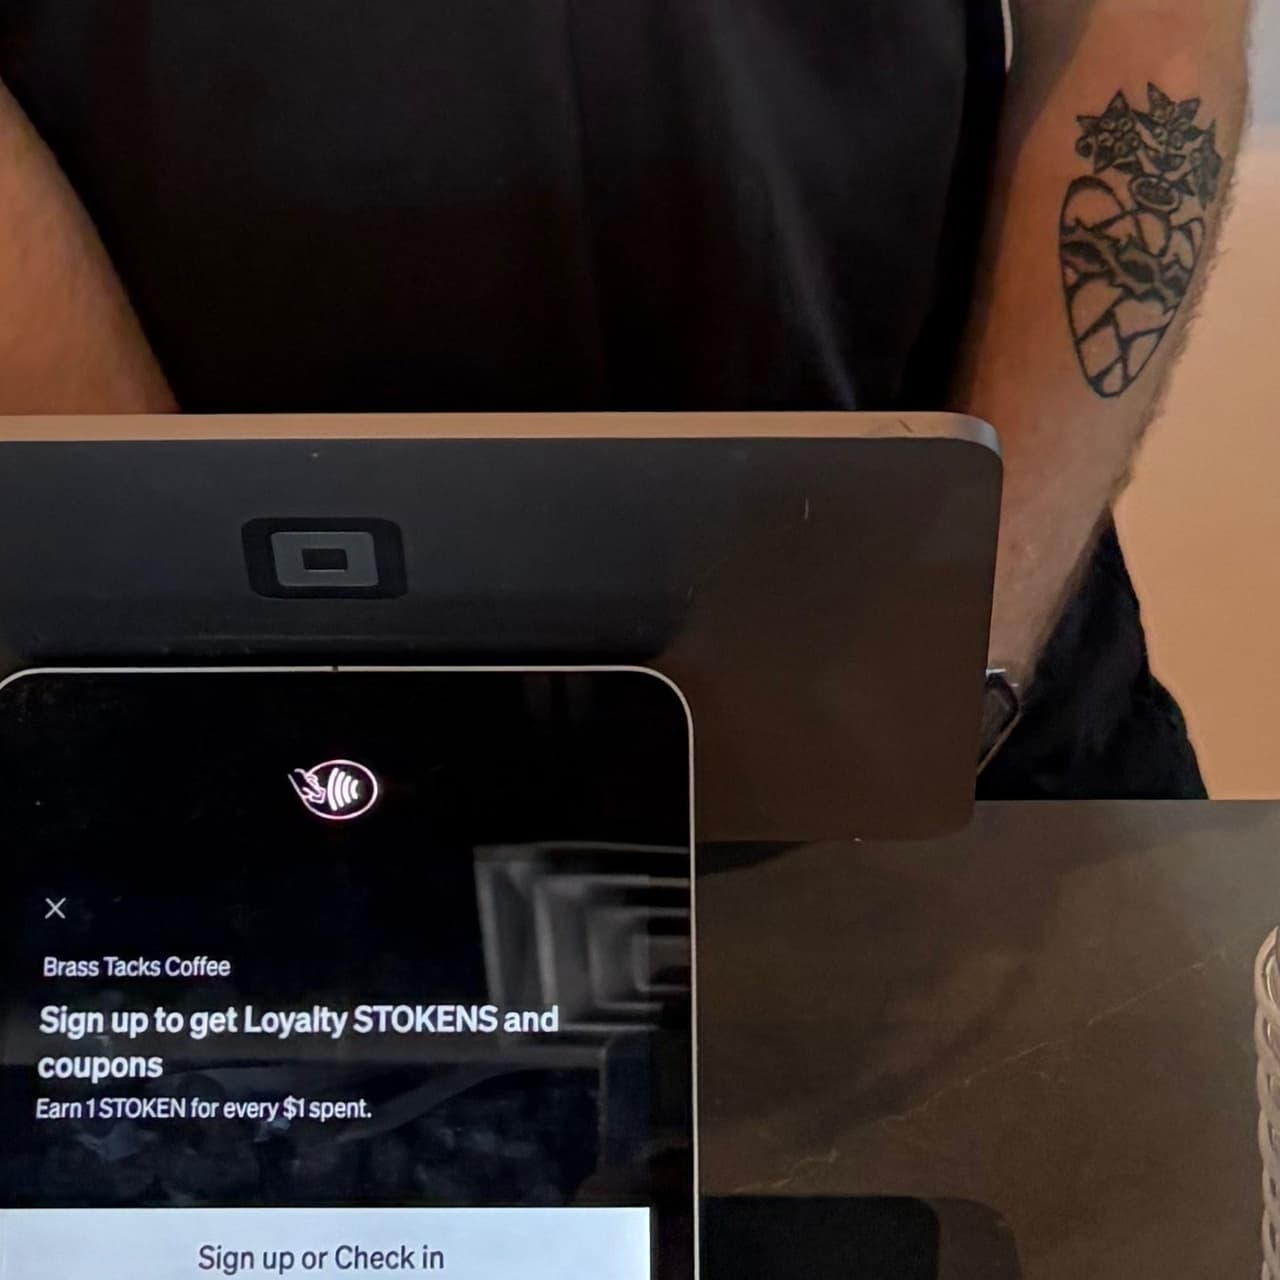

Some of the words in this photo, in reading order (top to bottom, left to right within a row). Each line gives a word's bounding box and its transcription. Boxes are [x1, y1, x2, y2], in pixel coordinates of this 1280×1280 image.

[44, 957, 99, 976] Brass
[103, 957, 161, 976] Tacks
[165, 956, 231, 976] Coffee
[40, 1006, 104, 1040] Sign
[112, 1012, 148, 1038] up
[154, 1007, 184, 1033] to
[190, 1007, 237, 1039] get
[245, 1006, 348, 1038] Loyalty
[354, 1005, 498, 1033] STOKENS
[504, 1005, 559, 1032] and
[38, 1057, 163, 1083] coupons
[36, 1098, 82, 1118] Earn
[86, 1098, 95, 1118] 1
[99, 1098, 186, 1118] STOKEN
[191, 1097, 219, 1118] for
[223, 1102, 279, 1123] every
[283, 1096, 304, 1120] $1
[309, 1099, 371, 1121] spent.
[199, 1245, 255, 1275] Sign
[263, 1251, 294, 1275] up
[302, 1251, 328, 1269] or
[335, 1245, 414, 1269] Check
[421, 1245, 444, 1269] in
